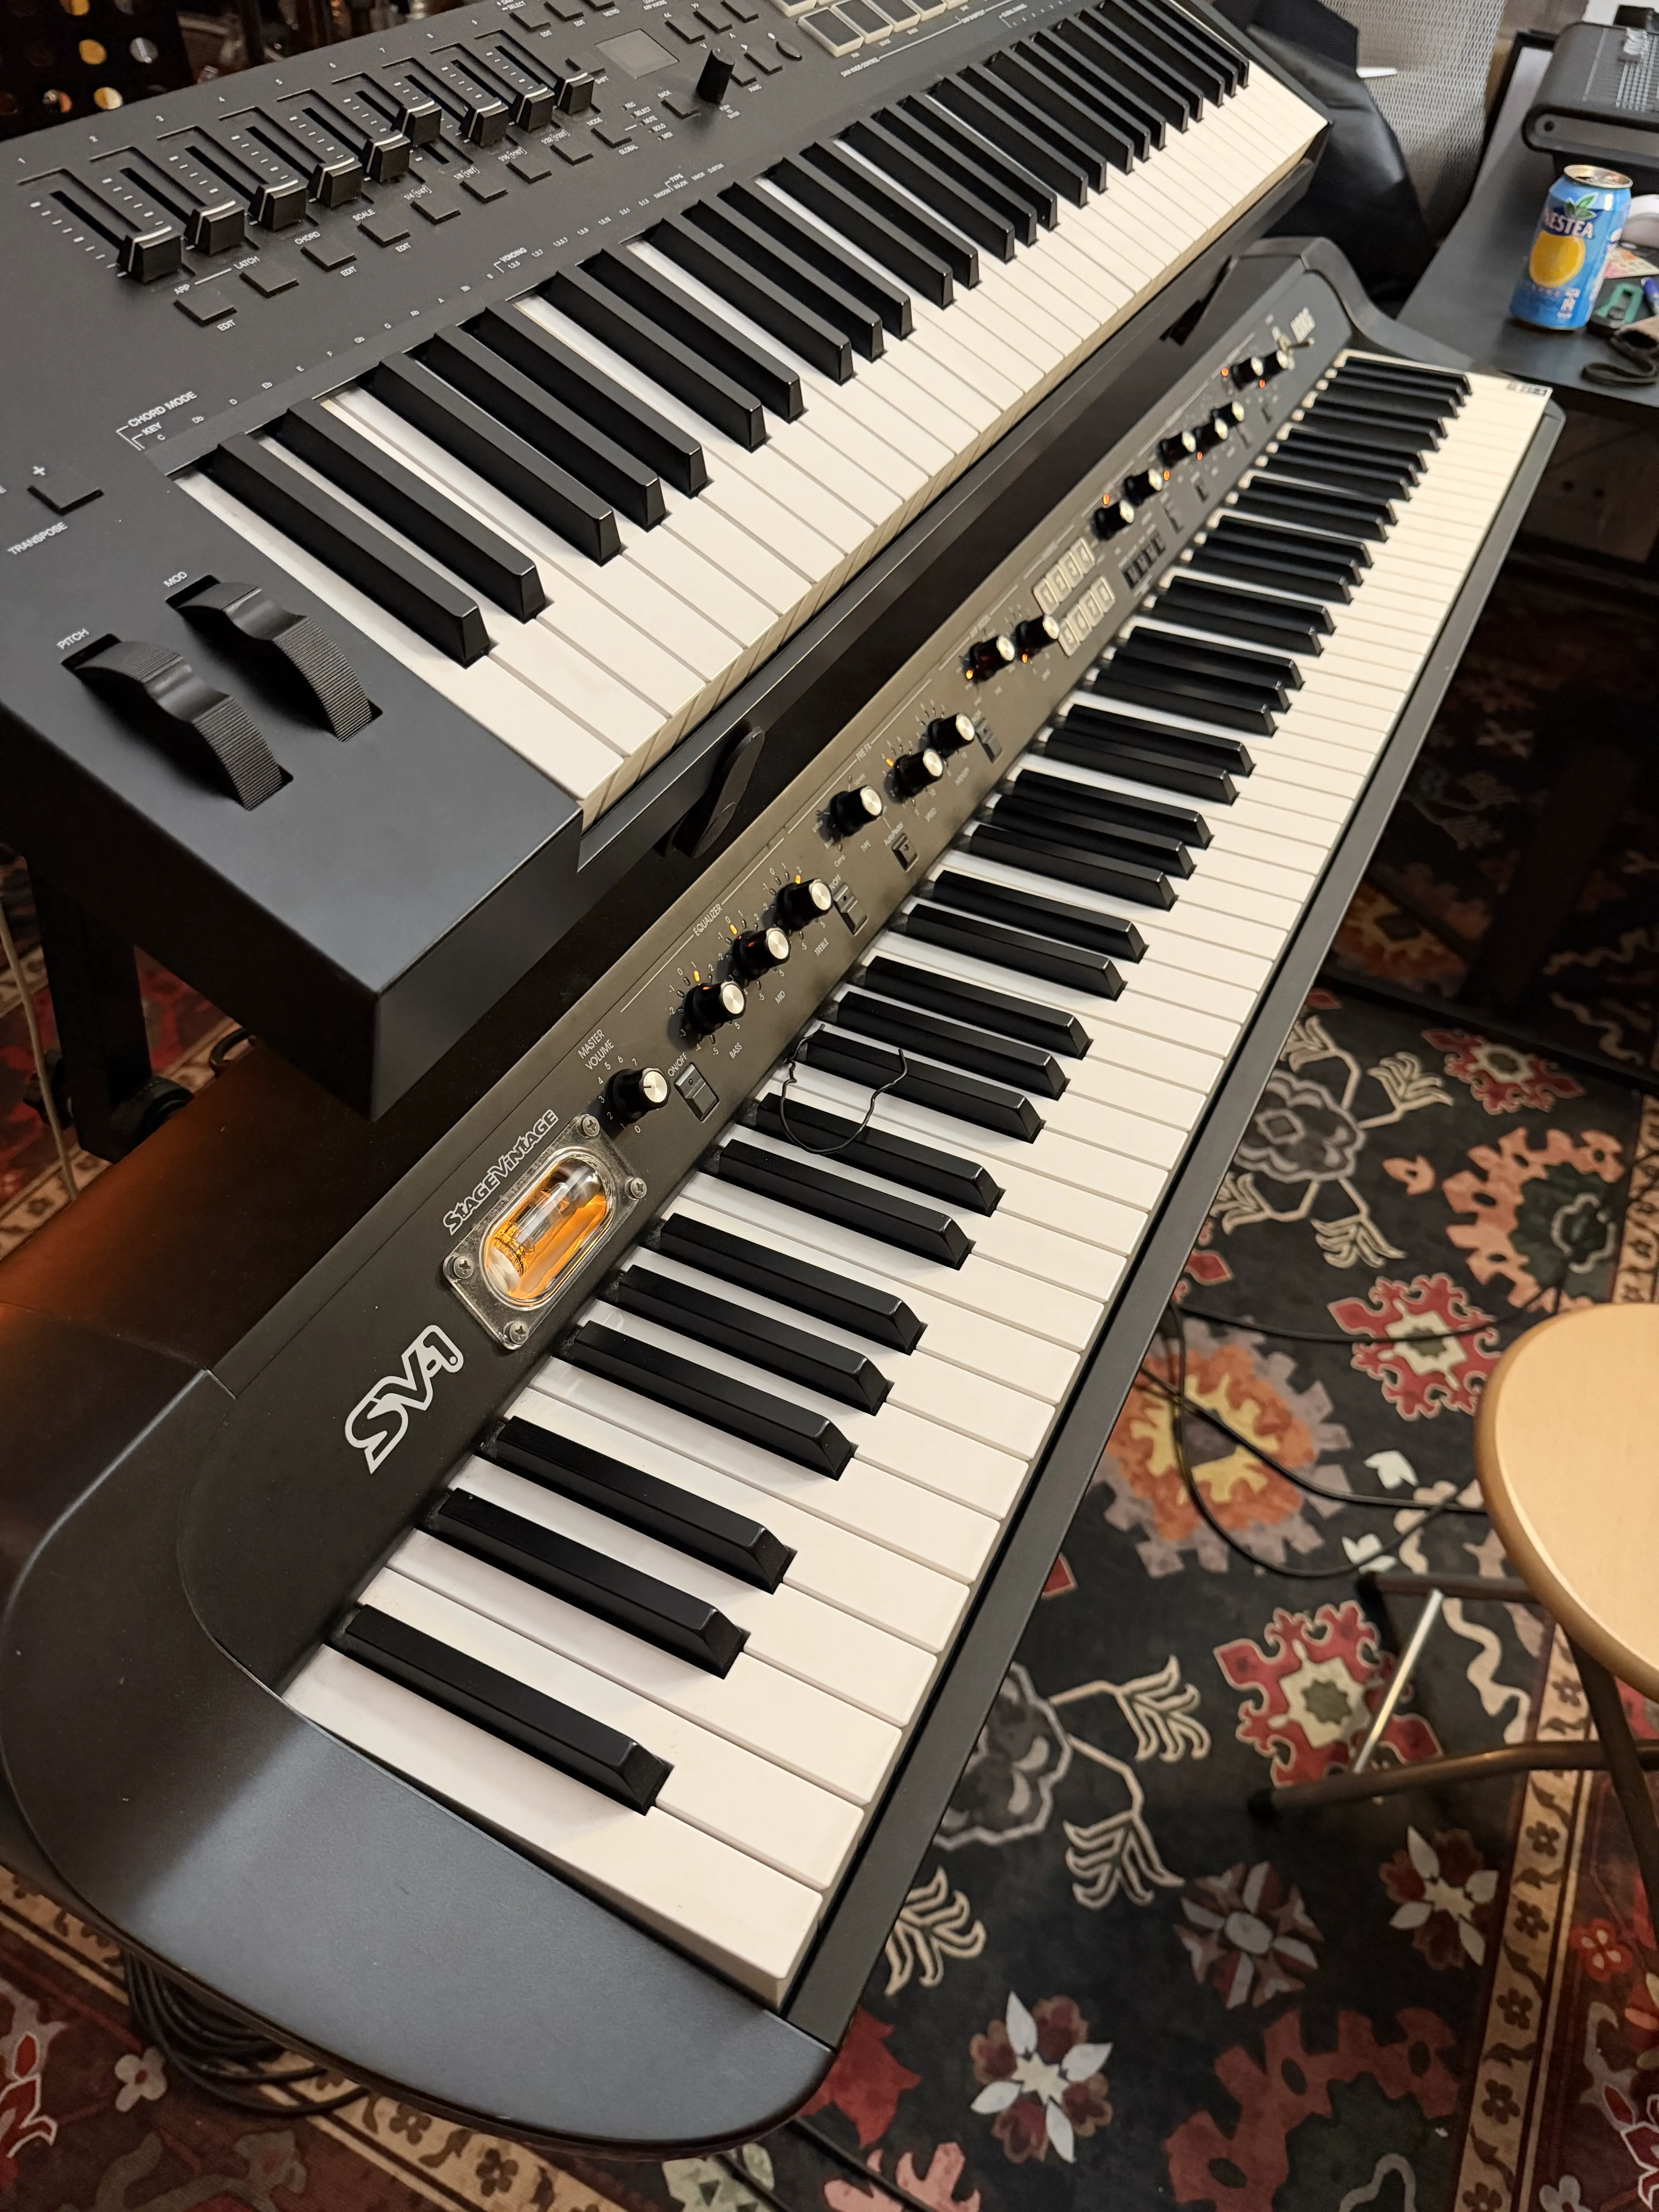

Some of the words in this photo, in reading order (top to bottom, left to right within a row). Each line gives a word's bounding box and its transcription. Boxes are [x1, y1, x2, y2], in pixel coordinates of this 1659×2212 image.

[507, 1, 526, 10] SELECT
[634, 106, 651, 117] SELECT
[586, 117, 603, 126] MODE
[643, 115, 658, 124] MUTE
[652, 123, 666, 131] SOLO
[618, 144, 638, 155] GLOBAL
[353, 209, 376, 222] SCALE
[294, 231, 321, 245] CHORD
[396, 242, 411, 254] EDIT
[500, 247, 527, 263] VOICING
[234, 255, 260, 270] LATCH
[340, 266, 357, 277] EDIT
[173, 284, 191, 295] ARP
[217, 319, 236, 331] EDIT
[128, 405, 166, 428] CHORD
[164, 390, 197, 410] MODE
[192, 415, 204, 424] Db
[142, 422, 163, 436] KEY
[7, 521, 68, 555] TRANSPOSE
[163, 571, 188, 587] MOD
[57, 628, 89, 649] PITCH
[693, 903, 723, 936] EQUALIZER
[814, 938, 829, 956] TREBLE
[775, 990, 785, 1004] MID
[578, 1029, 605, 1059] MASTER
[729, 1042, 742, 1059] BASS
[585, 1039, 614, 1070] VOLUME
[598, 1077, 604, 1085] 4
[605, 1062, 611, 1070] 5
[632, 1058, 637, 1066] 7
[668, 1052, 688, 1077] ON/OFF
[599, 1096, 605, 1104] 3
[607, 1111, 613, 1120] 2
[634, 1125, 641, 1133] 0
